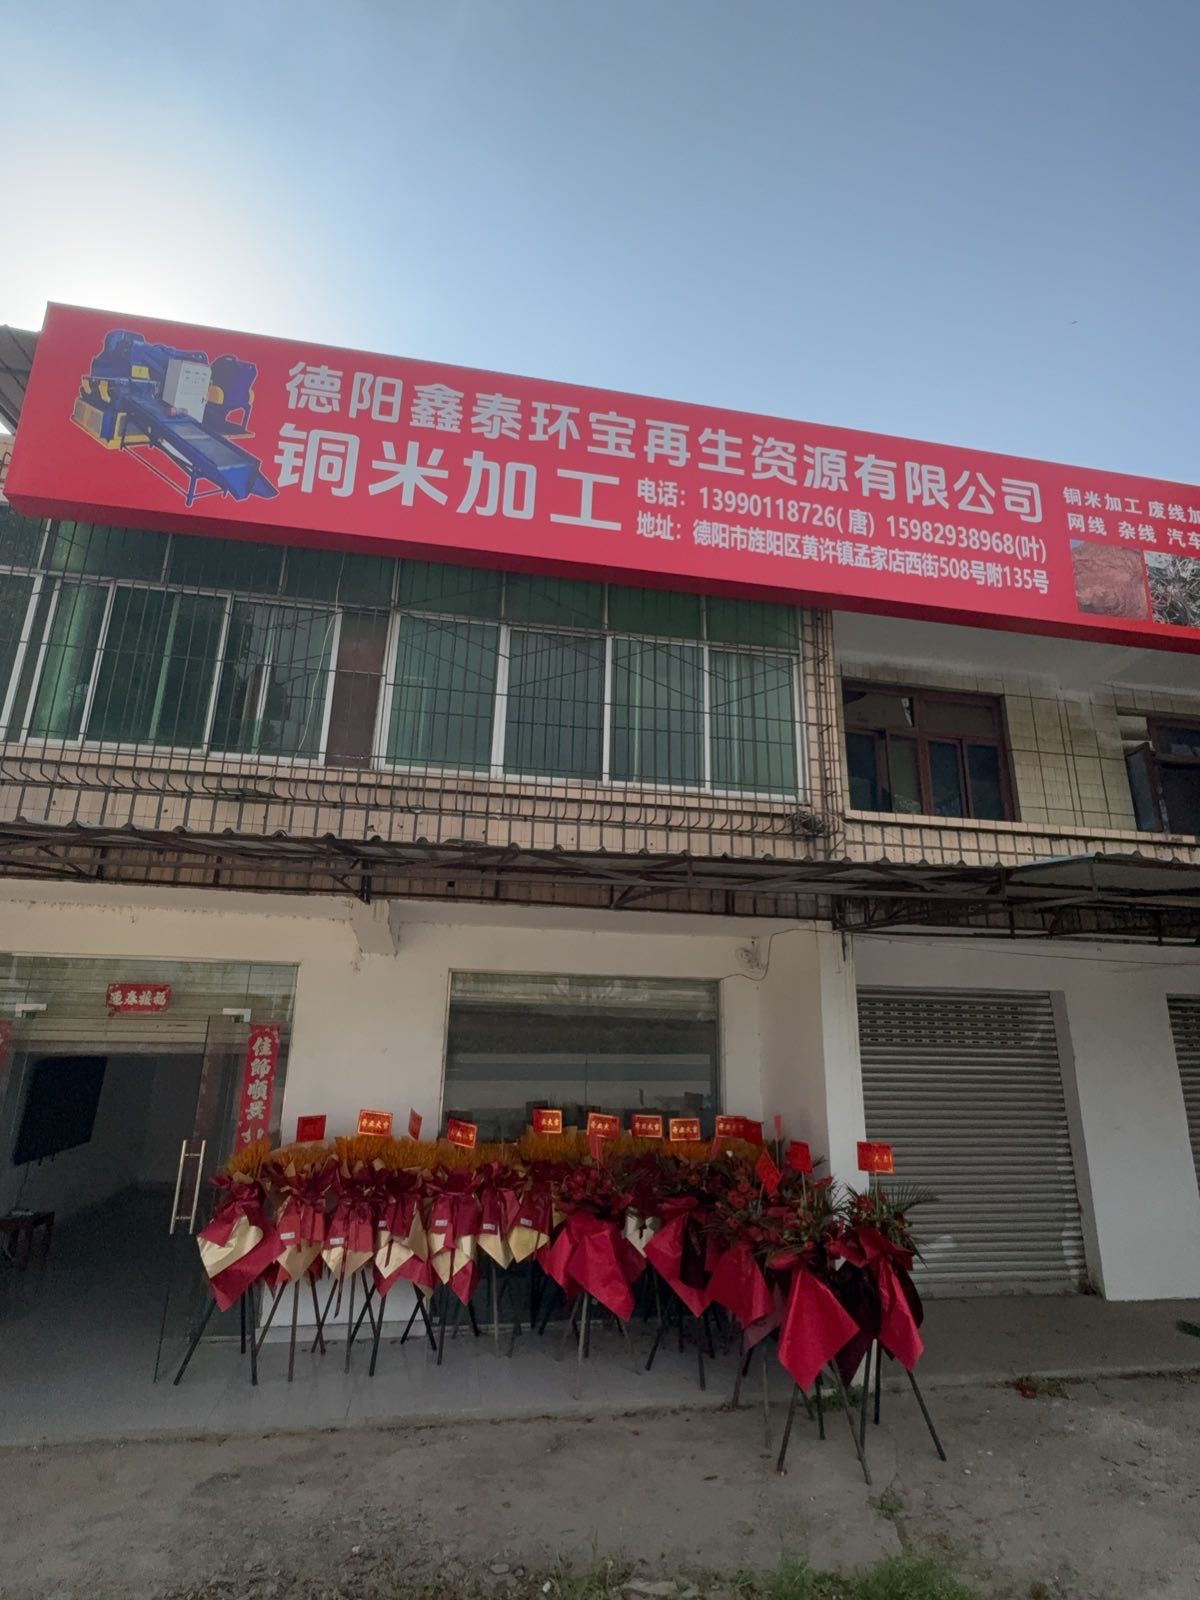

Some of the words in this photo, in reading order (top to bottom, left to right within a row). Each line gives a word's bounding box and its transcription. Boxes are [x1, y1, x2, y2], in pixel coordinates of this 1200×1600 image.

[273, 422, 622, 532] 铜米加工
[285, 361, 1043, 525] 德阳鑫泰环宝再生资源有限公司
[698, 486, 875, 539] 13990118726(唐)
[886, 515, 1047, 564] 15982938968(叶)
[1062, 486, 1143, 515] 铜米加工
[1067, 512, 1108, 537] 网线
[1118, 521, 1157, 544] 杂线
[692, 518, 1050, 595] 德阳市旌阳区黄许镇孟家店西街508号附135号
